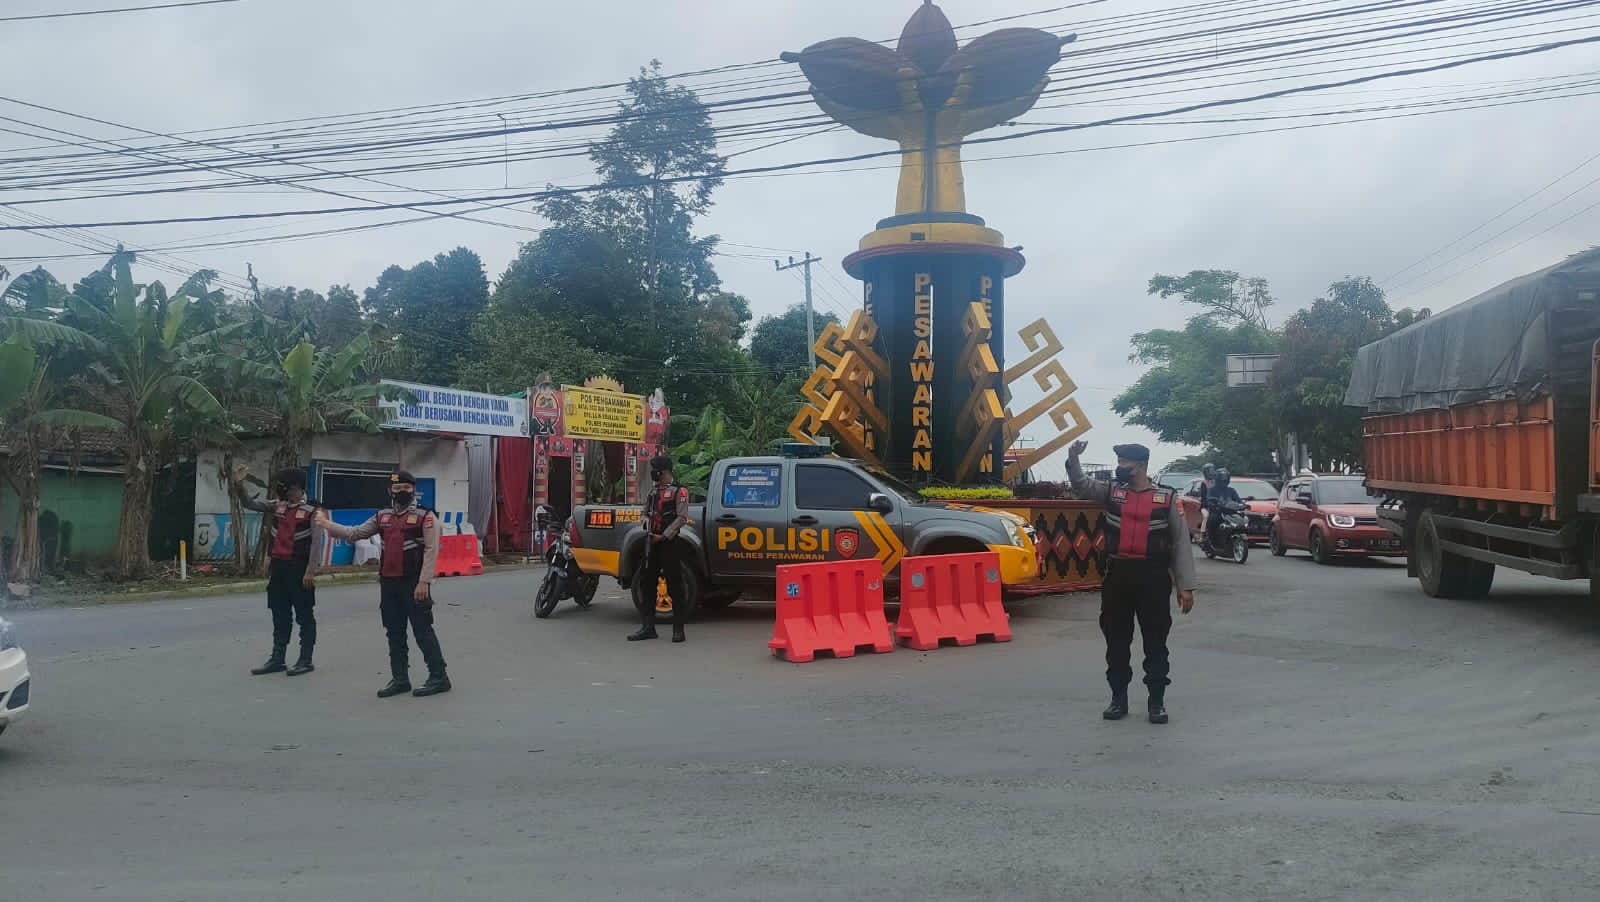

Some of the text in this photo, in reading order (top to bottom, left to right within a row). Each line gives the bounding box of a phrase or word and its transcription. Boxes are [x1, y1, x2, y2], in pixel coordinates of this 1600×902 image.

[910, 273, 935, 472] PESAWARAN
[463, 395, 490, 410] DENGAN
[490, 399, 509, 412] YAKIN
[580, 394, 631, 408] POS PENGAMANAN
[399, 403, 514, 427] SEHAT BERUSAHA DENGAN VAKSIN
[590, 513, 612, 524] 110
[717, 526, 830, 552] POLISI
[766, 552, 825, 560] PESAWARAN
